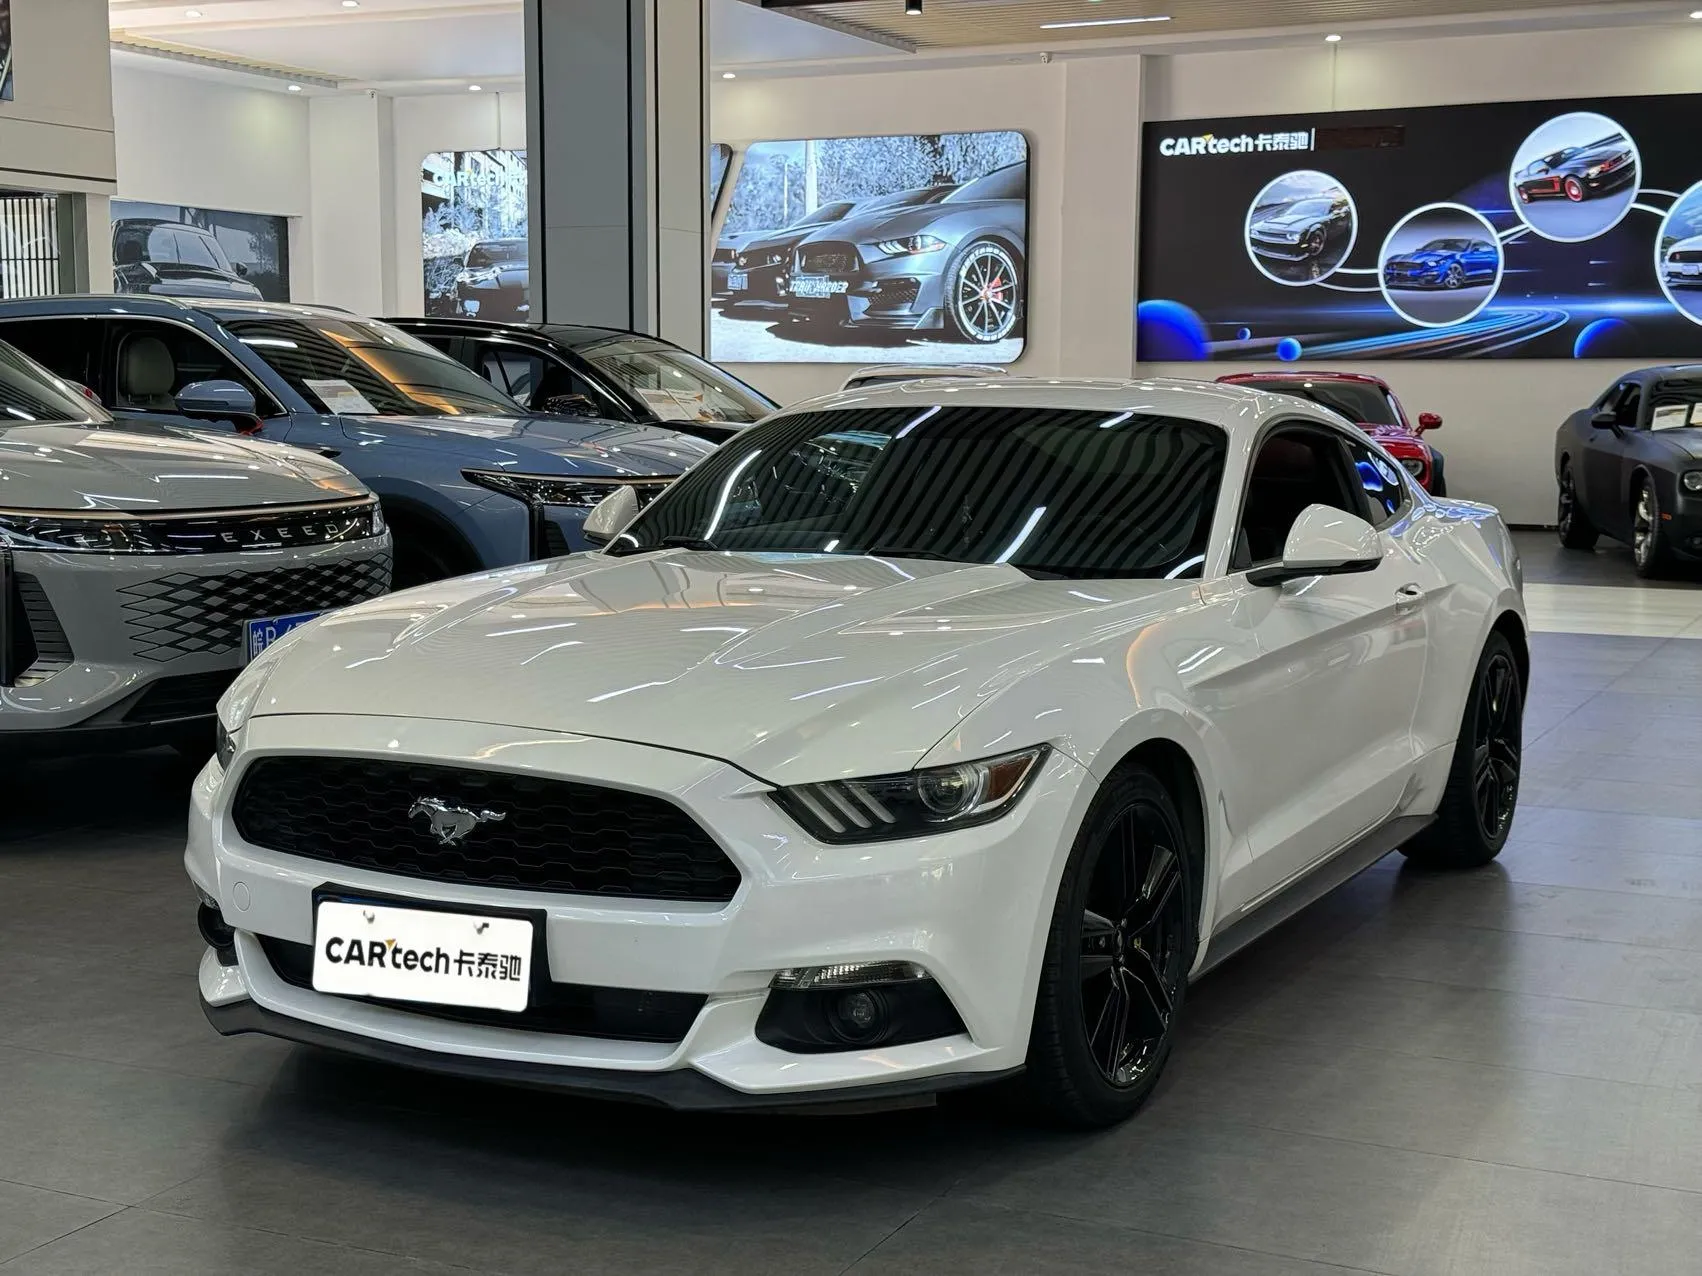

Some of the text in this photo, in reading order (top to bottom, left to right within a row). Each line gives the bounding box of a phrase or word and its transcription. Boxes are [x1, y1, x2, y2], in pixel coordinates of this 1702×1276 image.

[1159, 131, 1309, 156] CARtech 卡泰驰
[220, 523, 339, 543] EXEED
[325, 937, 522, 982] CARtech 卡泰驰
